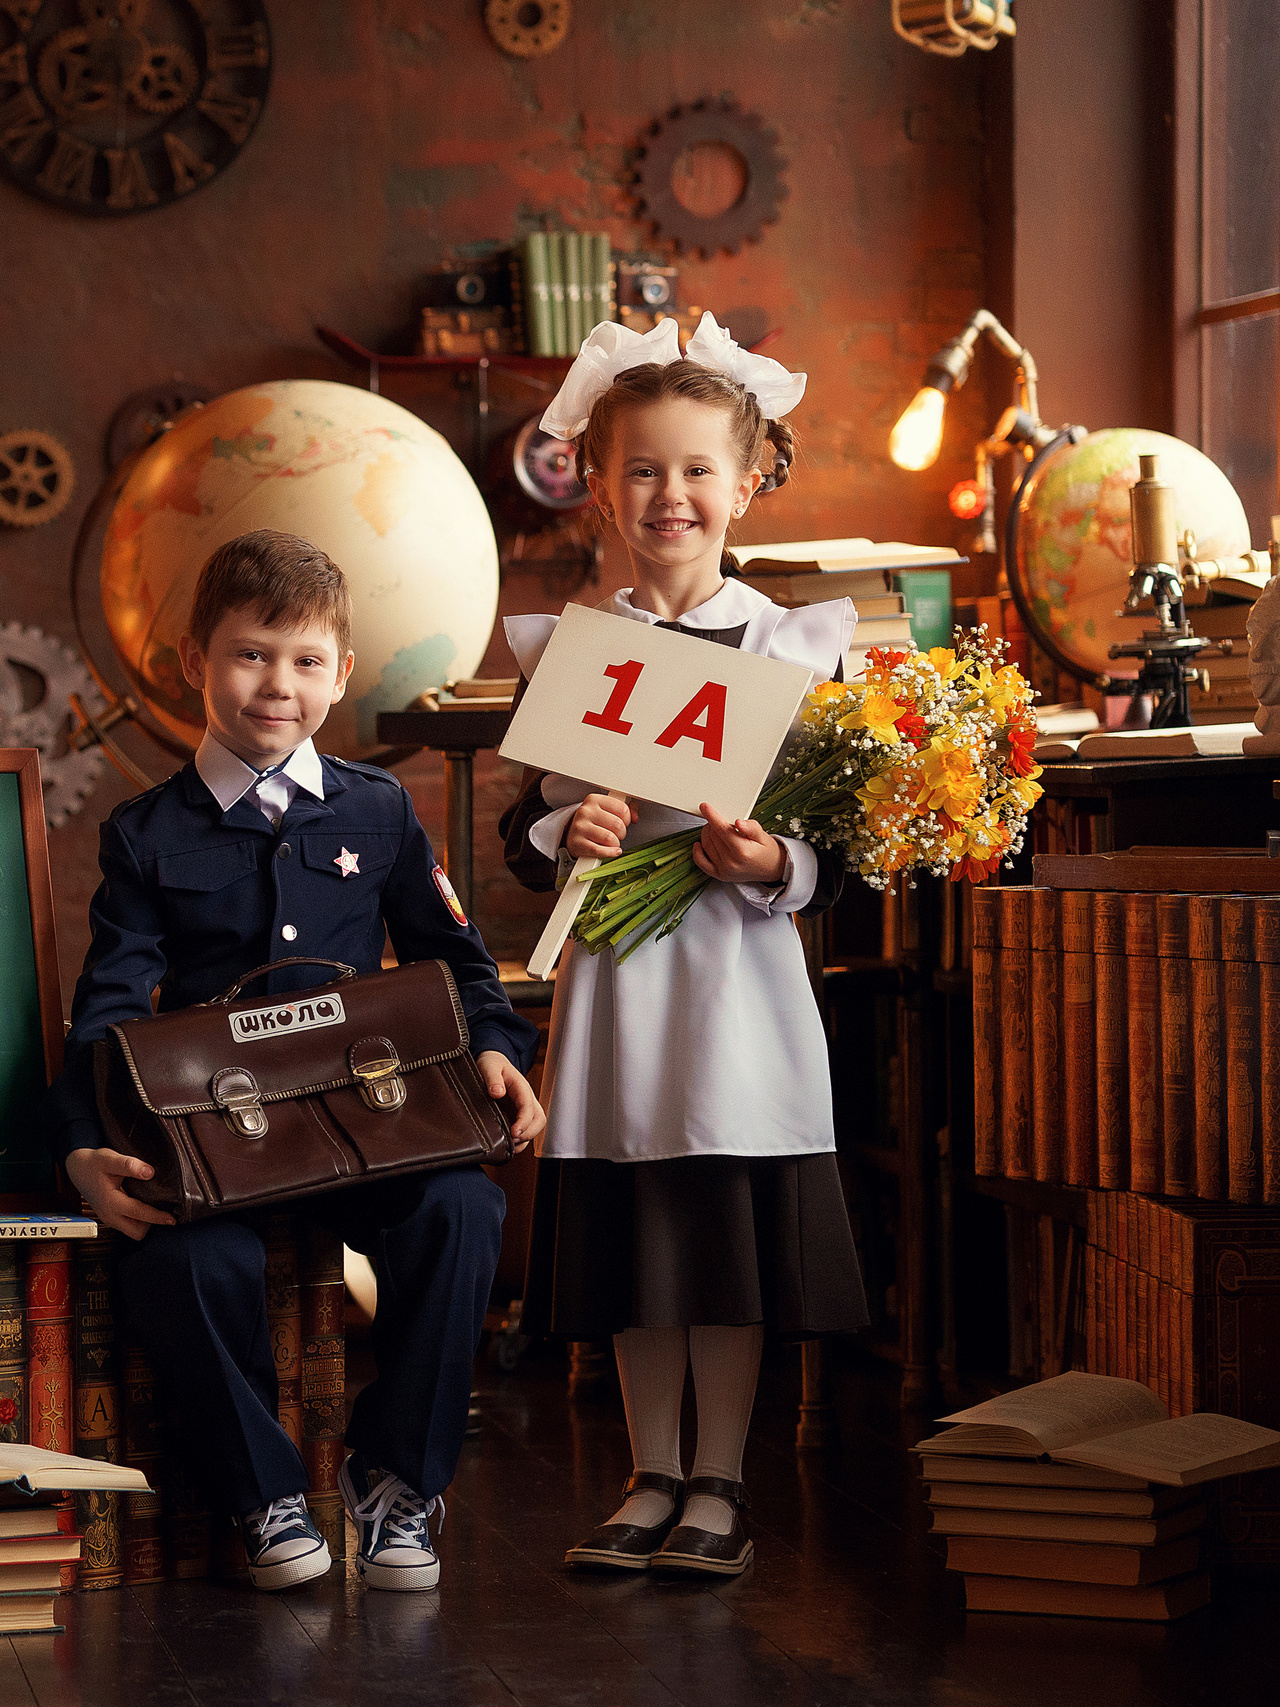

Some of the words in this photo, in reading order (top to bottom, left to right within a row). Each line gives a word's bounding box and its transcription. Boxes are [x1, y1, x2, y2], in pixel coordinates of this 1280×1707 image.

[86, 1290, 110, 1311] THE
[306, 1381, 342, 1396] POEMS
[91, 1393, 111, 1423] A
